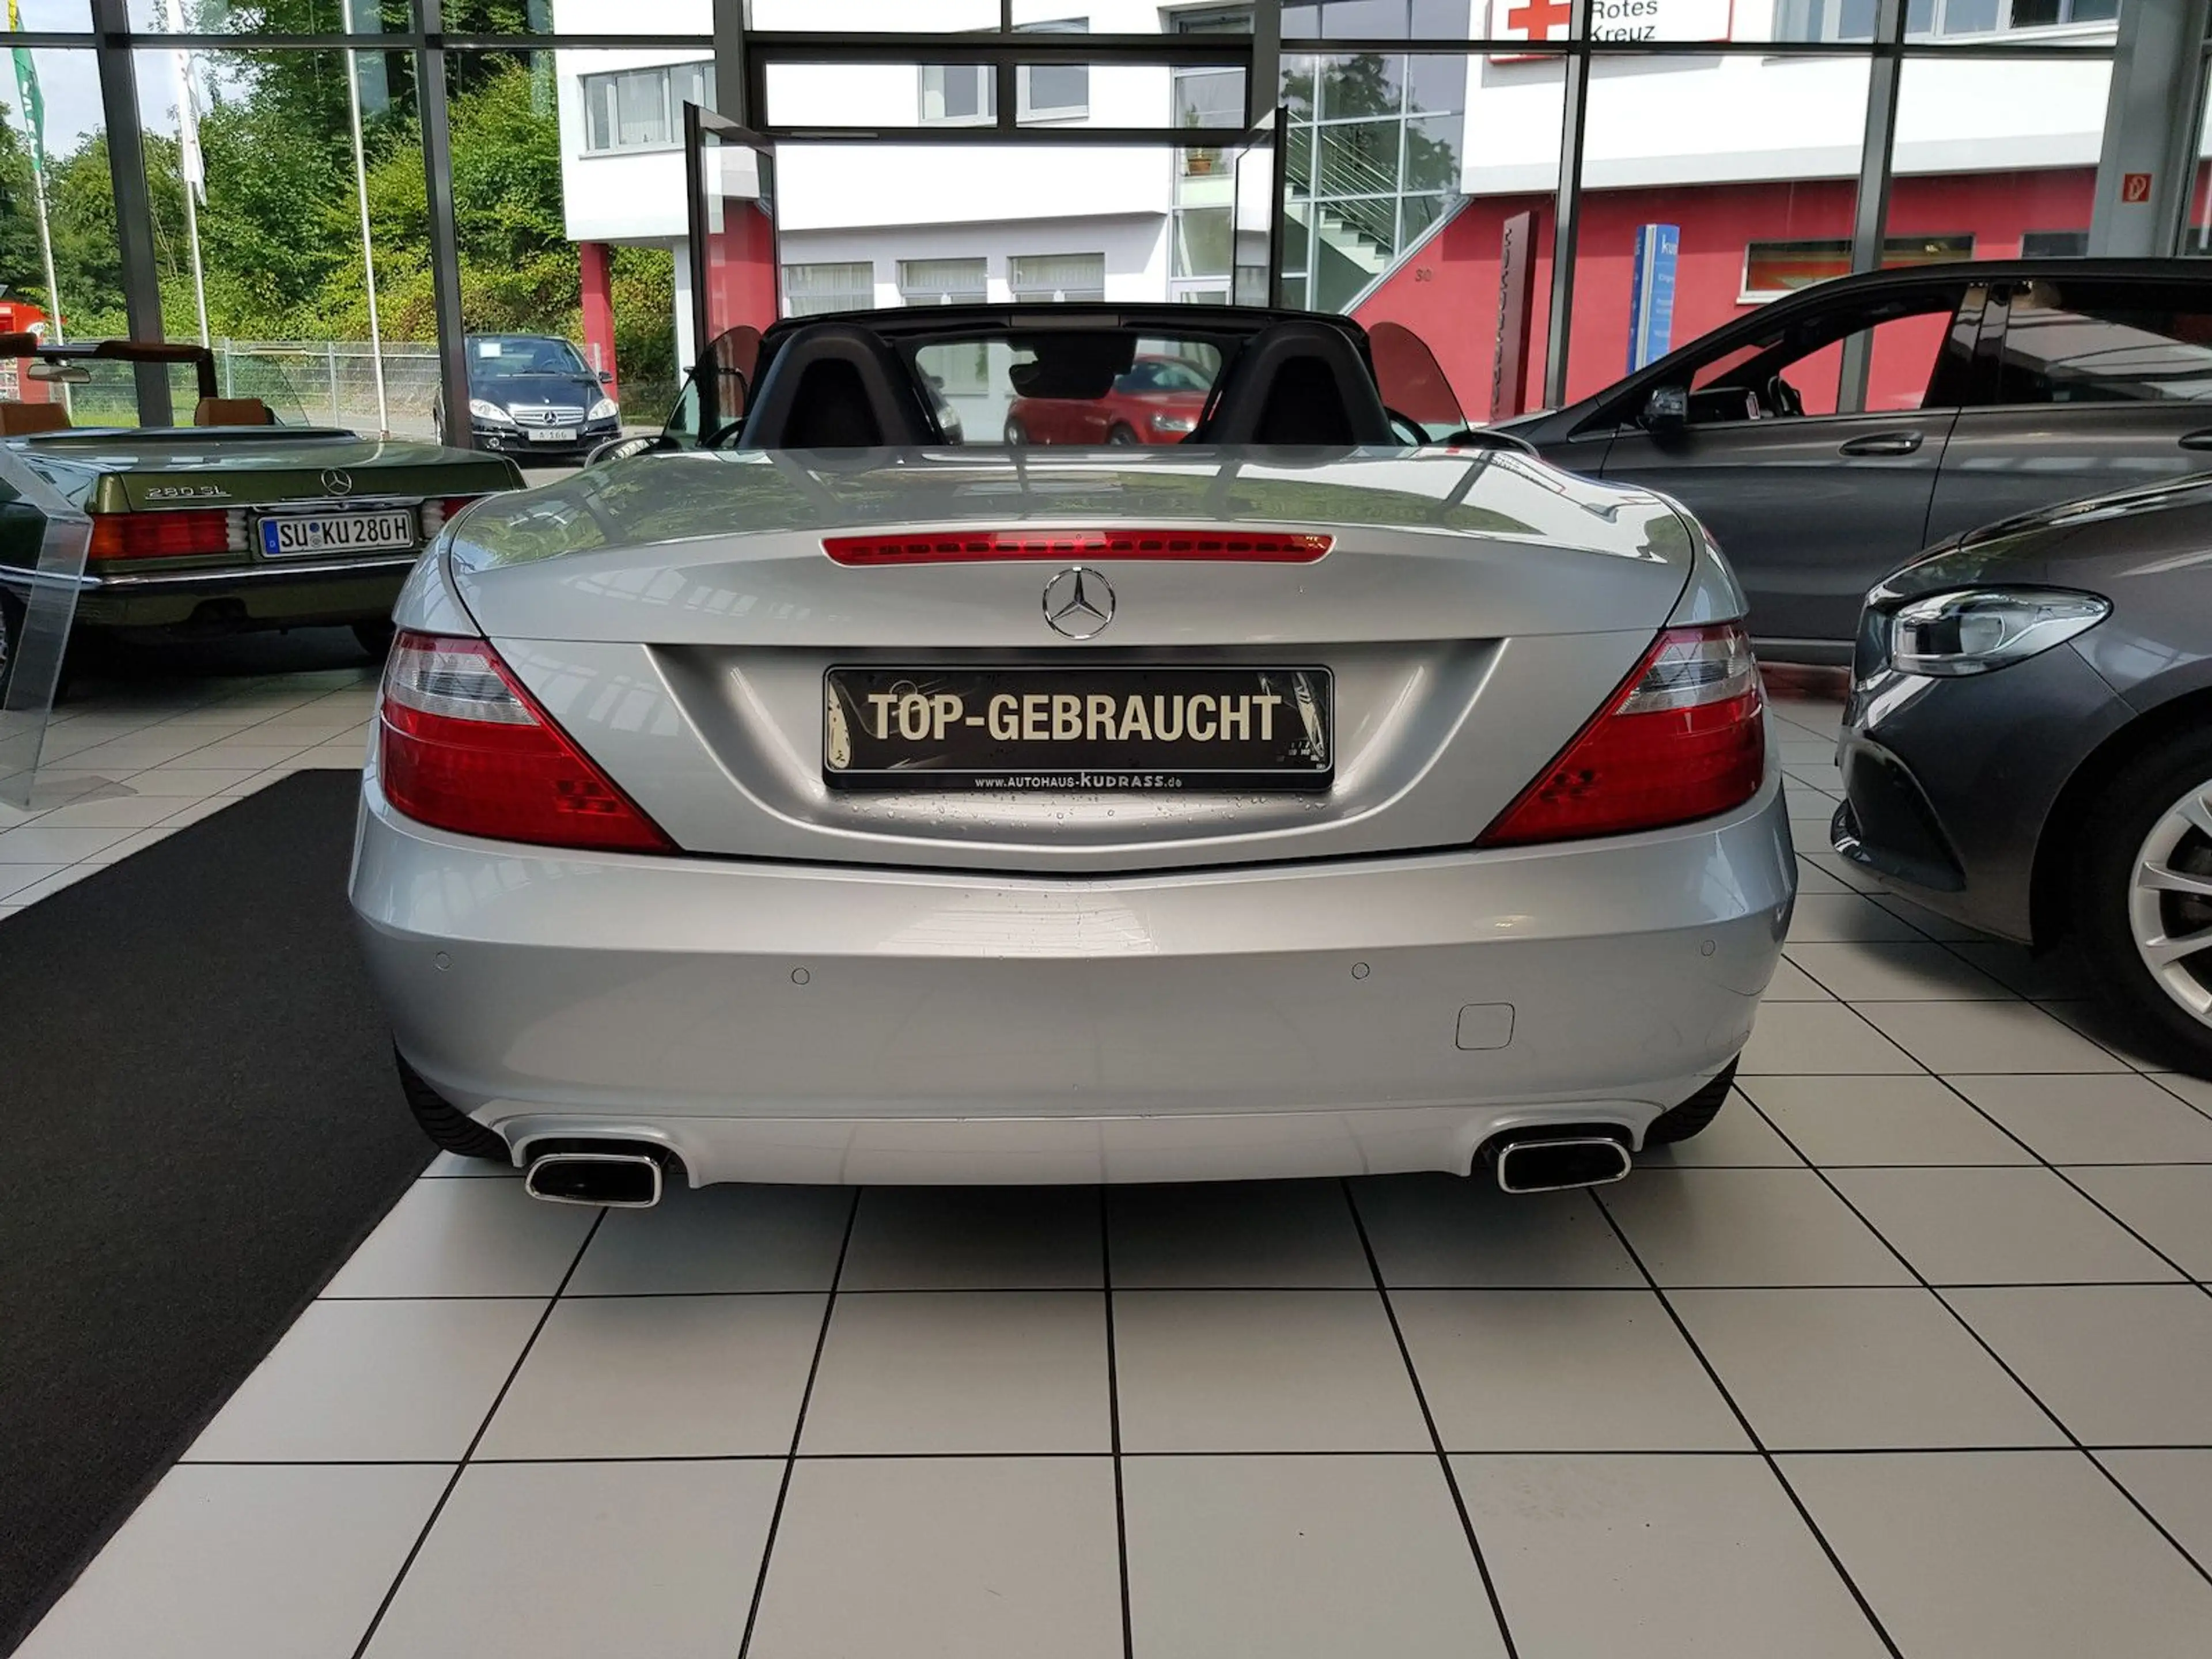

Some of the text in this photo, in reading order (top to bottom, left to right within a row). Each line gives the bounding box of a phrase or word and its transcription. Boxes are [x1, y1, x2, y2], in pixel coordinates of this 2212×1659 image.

[1592, 0, 1657, 19] Rotes
[149, 487, 194, 498] 280
[280, 522, 308, 547] SU
[323, 520, 350, 544] KU
[354, 518, 392, 543] 280
[395, 517, 407, 540] H
[868, 694, 1282, 741] TOP-GEBRAUCHT
